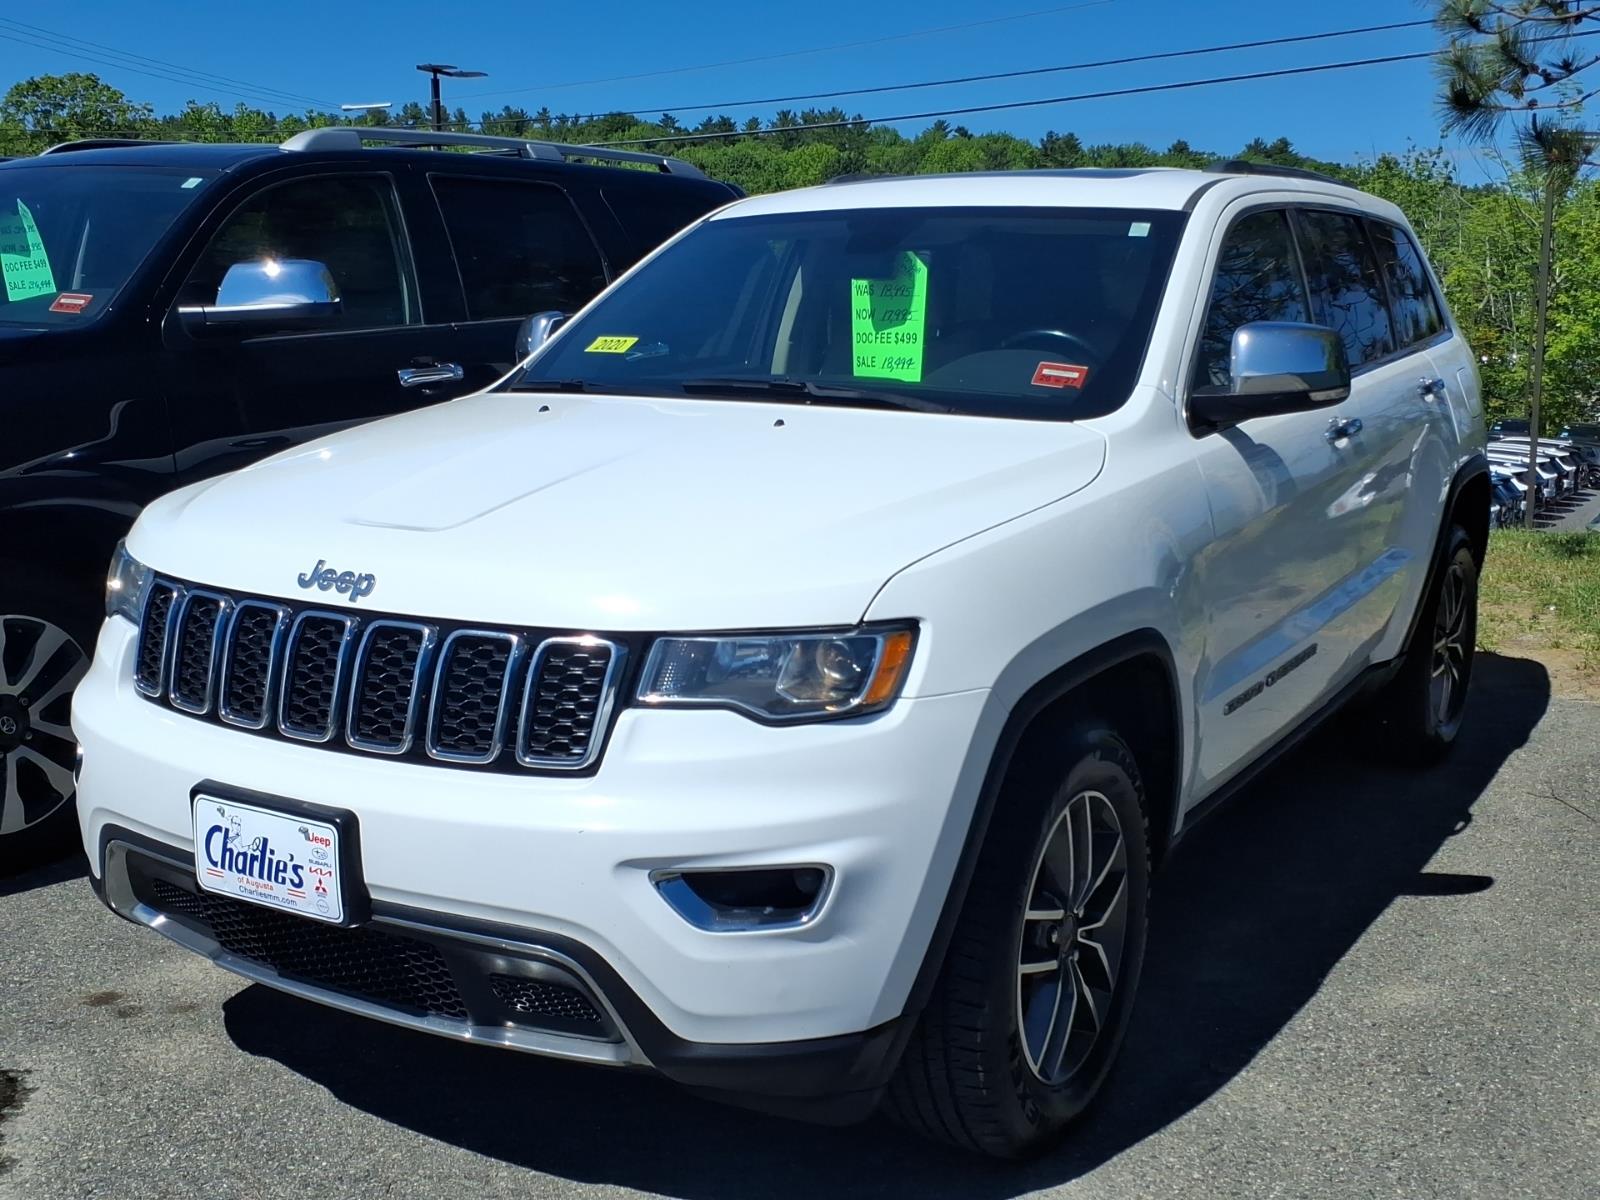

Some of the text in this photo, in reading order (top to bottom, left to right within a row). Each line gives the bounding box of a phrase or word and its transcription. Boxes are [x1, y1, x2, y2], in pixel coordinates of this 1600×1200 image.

[5, 259, 47, 272] DOC FEE $499
[8, 281, 26, 291] SALE
[856, 284, 874, 296] WAS
[855, 308, 915, 323] NOW 17,995
[593, 339, 627, 350] 2020
[856, 332, 917, 345] DOC FEE $499
[856, 356, 876, 368] SALE
[297, 559, 376, 602] Jeep
[307, 832, 331, 847] Jeep
[205, 824, 304, 889] Charlie's
[245, 878, 274, 891] Augusta
[239, 885, 297, 906] Charliesmm.com
